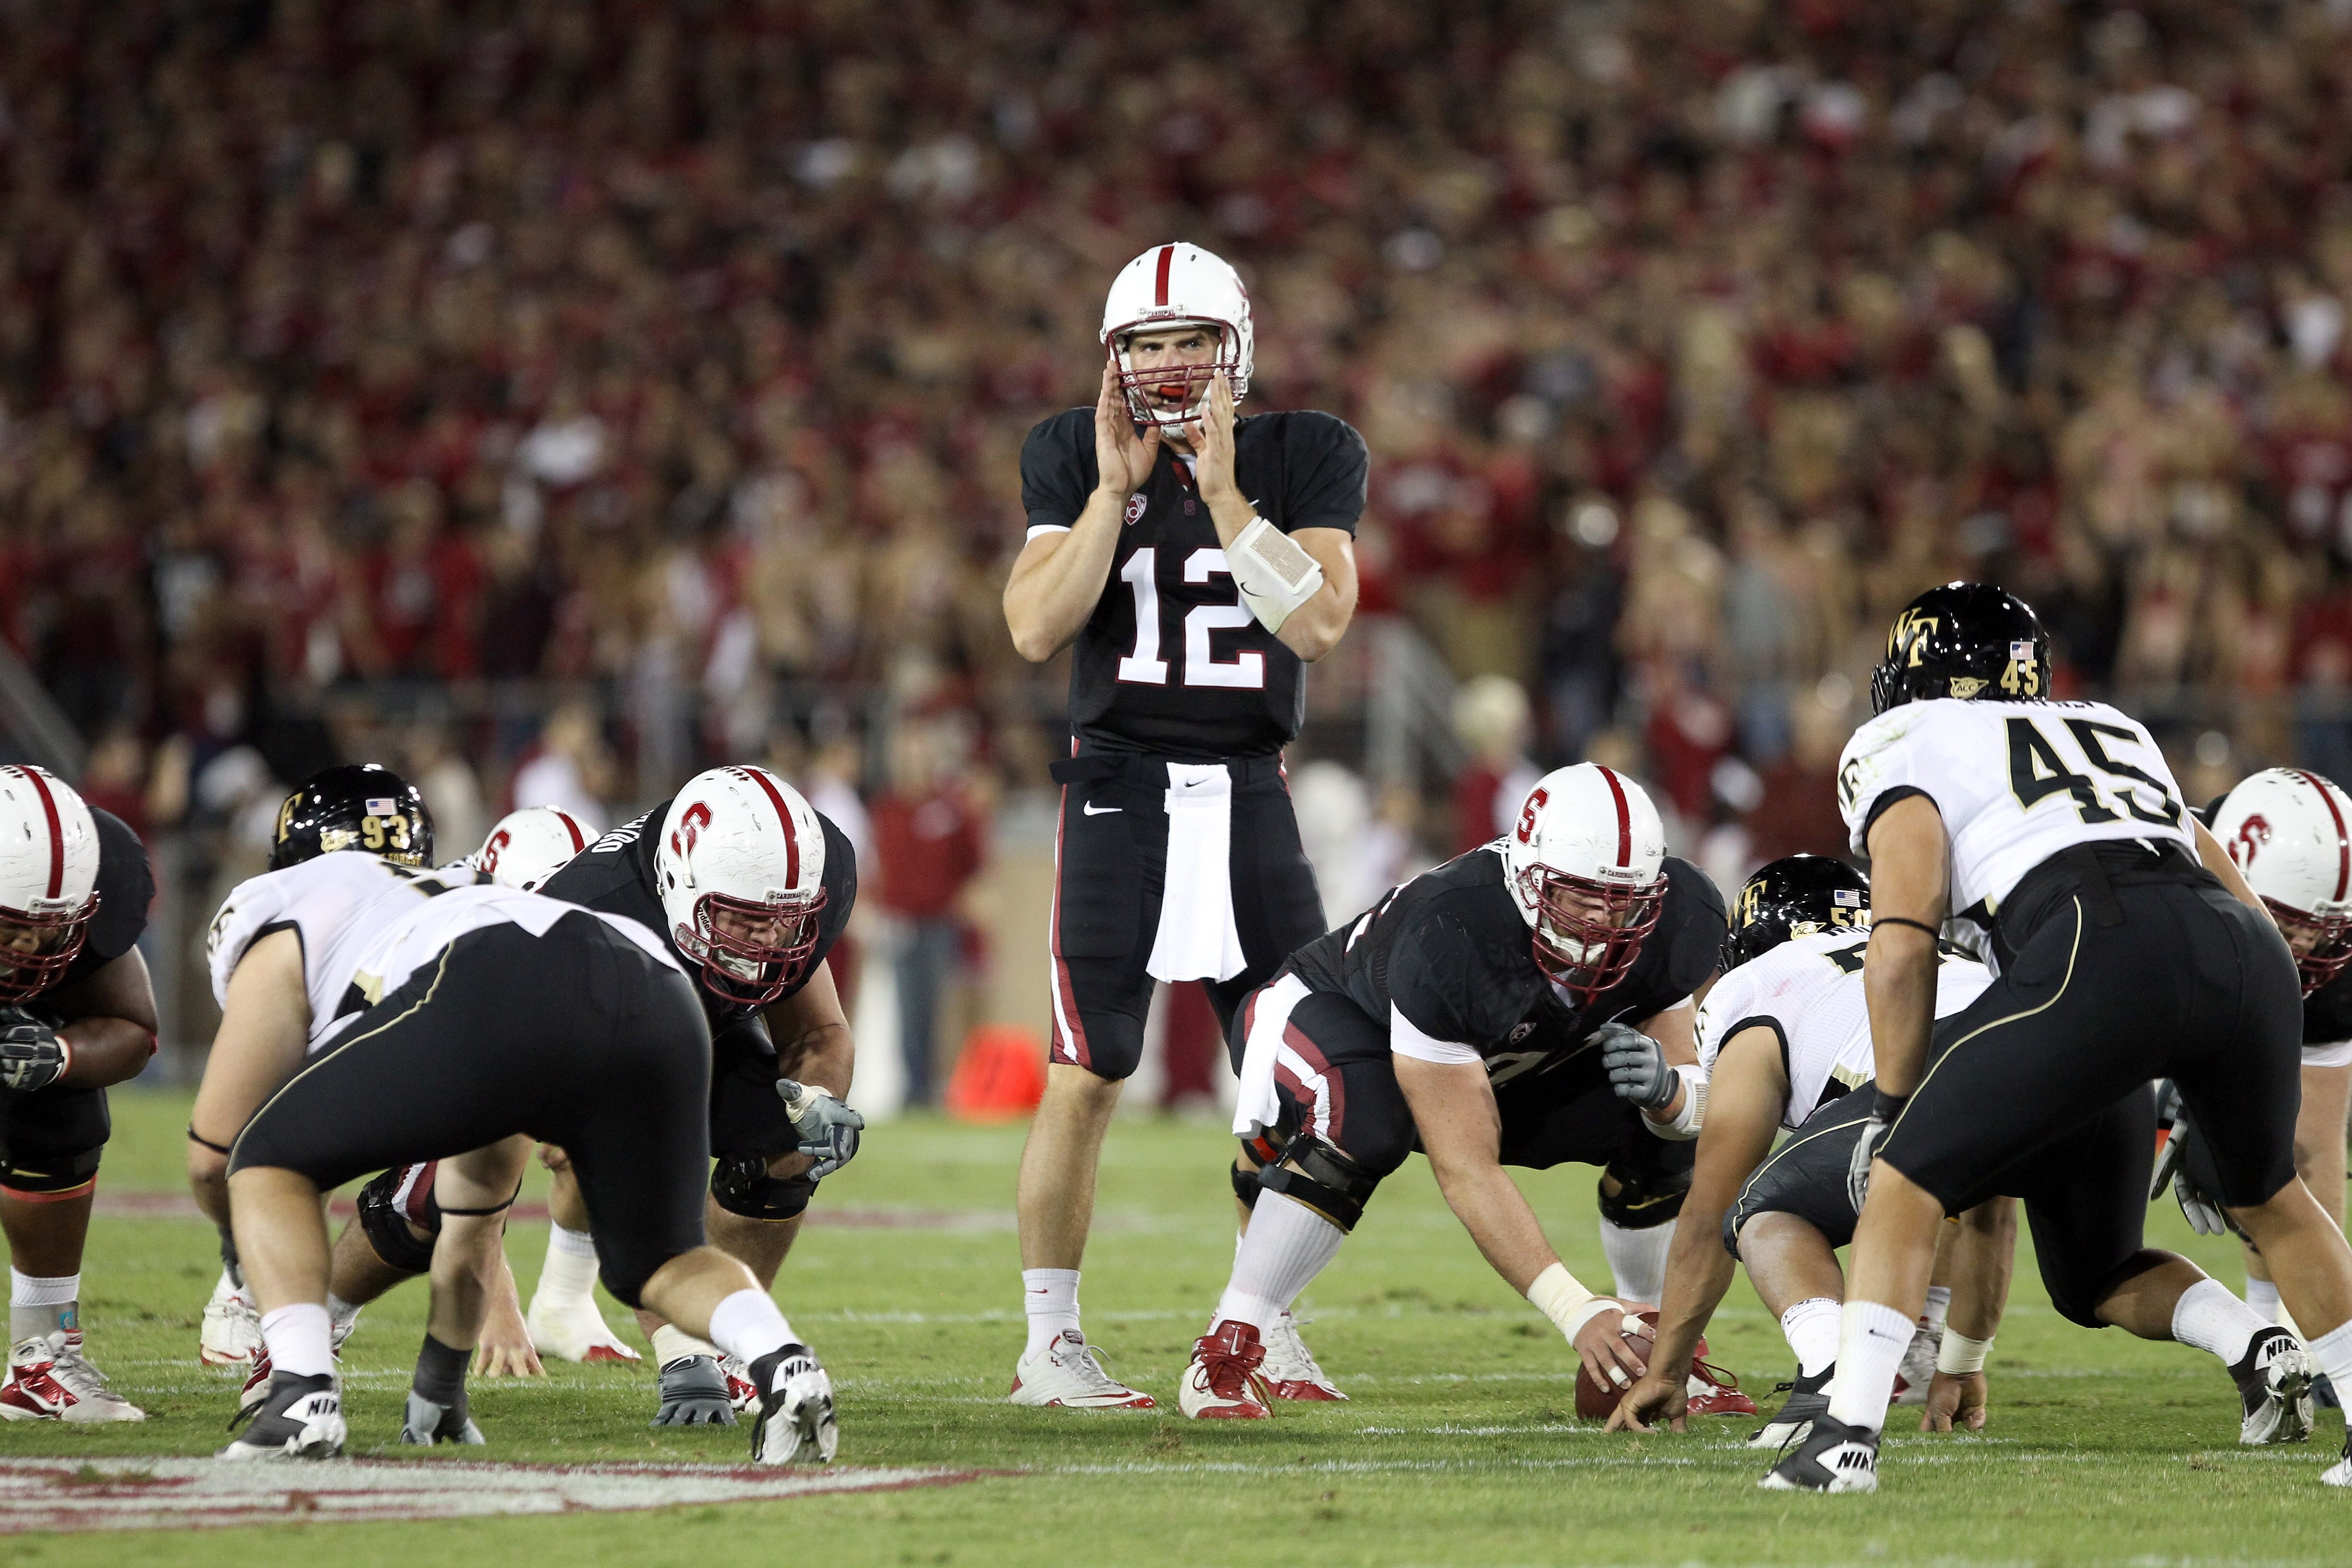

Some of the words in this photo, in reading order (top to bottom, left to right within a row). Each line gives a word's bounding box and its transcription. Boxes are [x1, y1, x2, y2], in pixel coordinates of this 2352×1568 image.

[1115, 546, 1266, 691] 12
[1888, 607, 1939, 668] WF
[1957, 684, 1976, 692] ACC
[2000, 660, 2039, 696] 45
[2003, 717, 2184, 831] 45
[361, 815, 411, 849] 93
[671, 800, 713, 861] S
[1517, 786, 1549, 846] S
[2228, 813, 2272, 870] S
[481, 829, 511, 873] S
[308, 1399, 337, 1417] NIK
